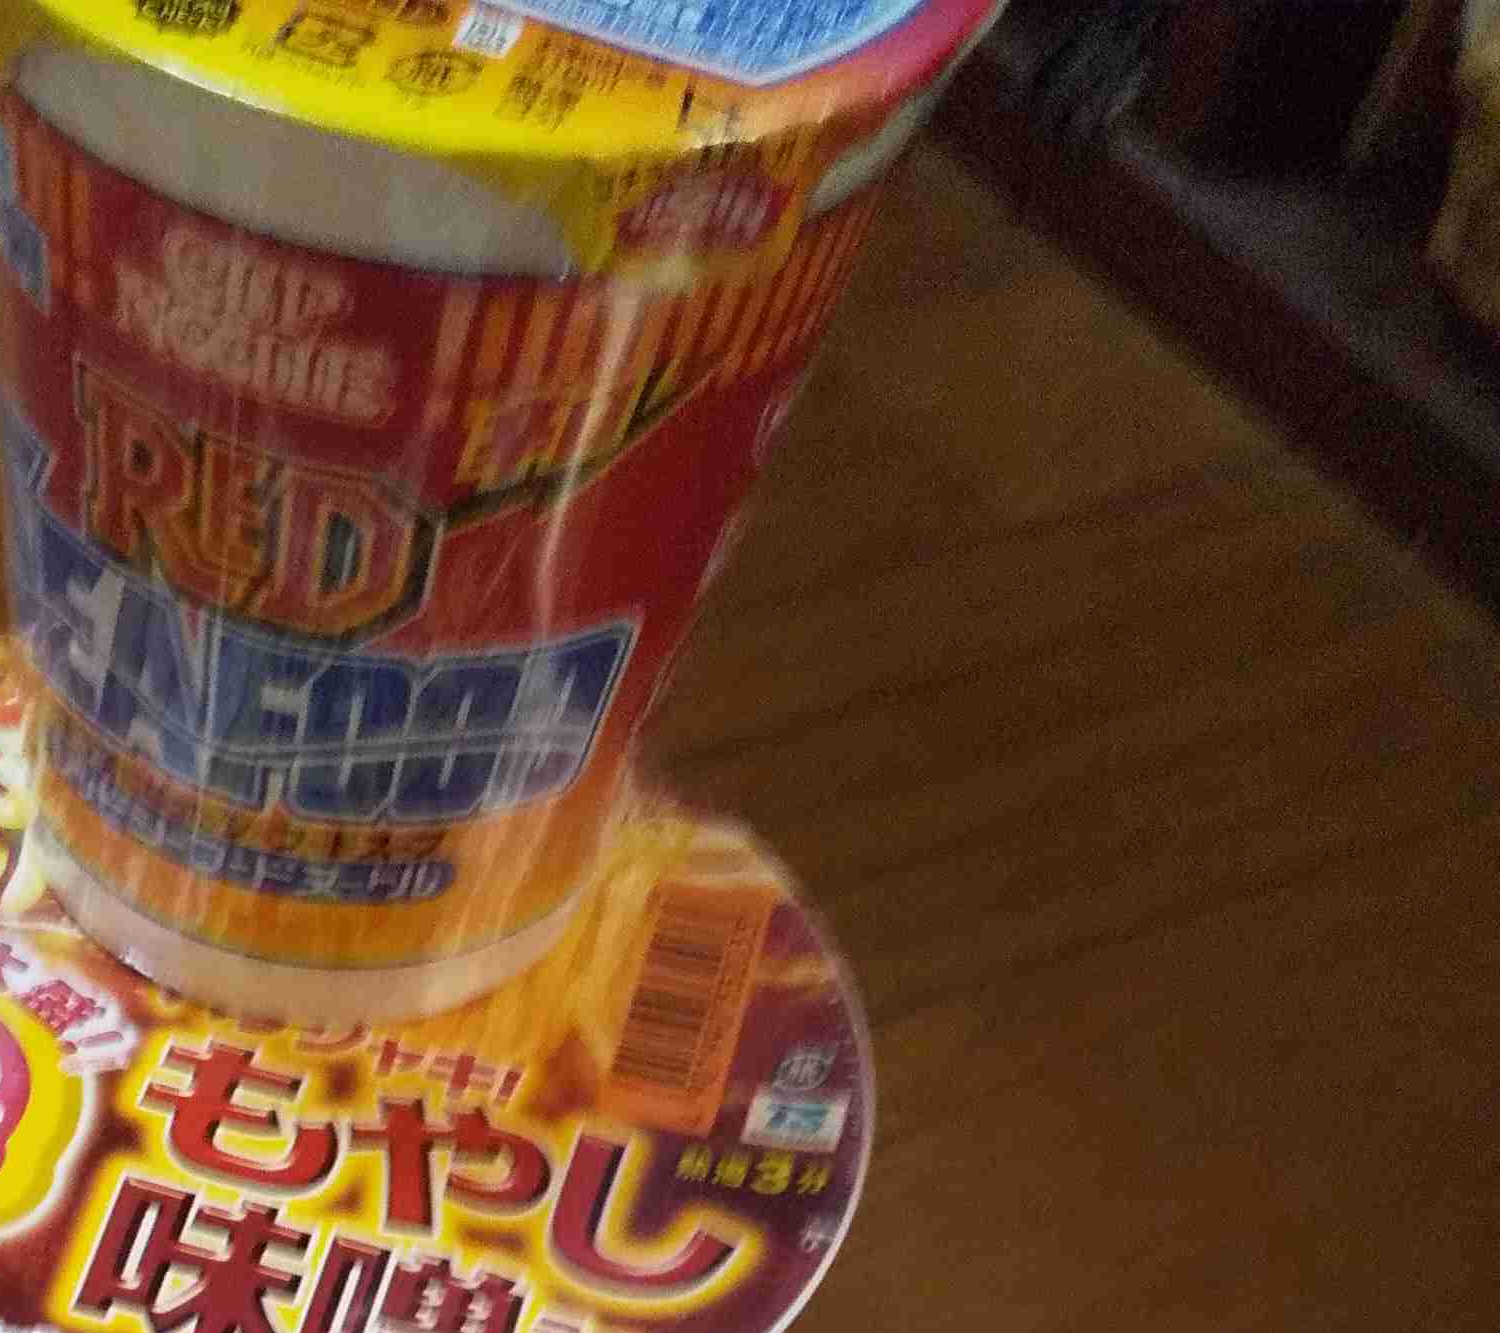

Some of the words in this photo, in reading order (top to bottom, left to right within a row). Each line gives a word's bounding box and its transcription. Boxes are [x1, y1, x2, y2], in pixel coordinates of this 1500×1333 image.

[82, 385, 416, 620] RED
[137, 1031, 736, 1305] もやし
